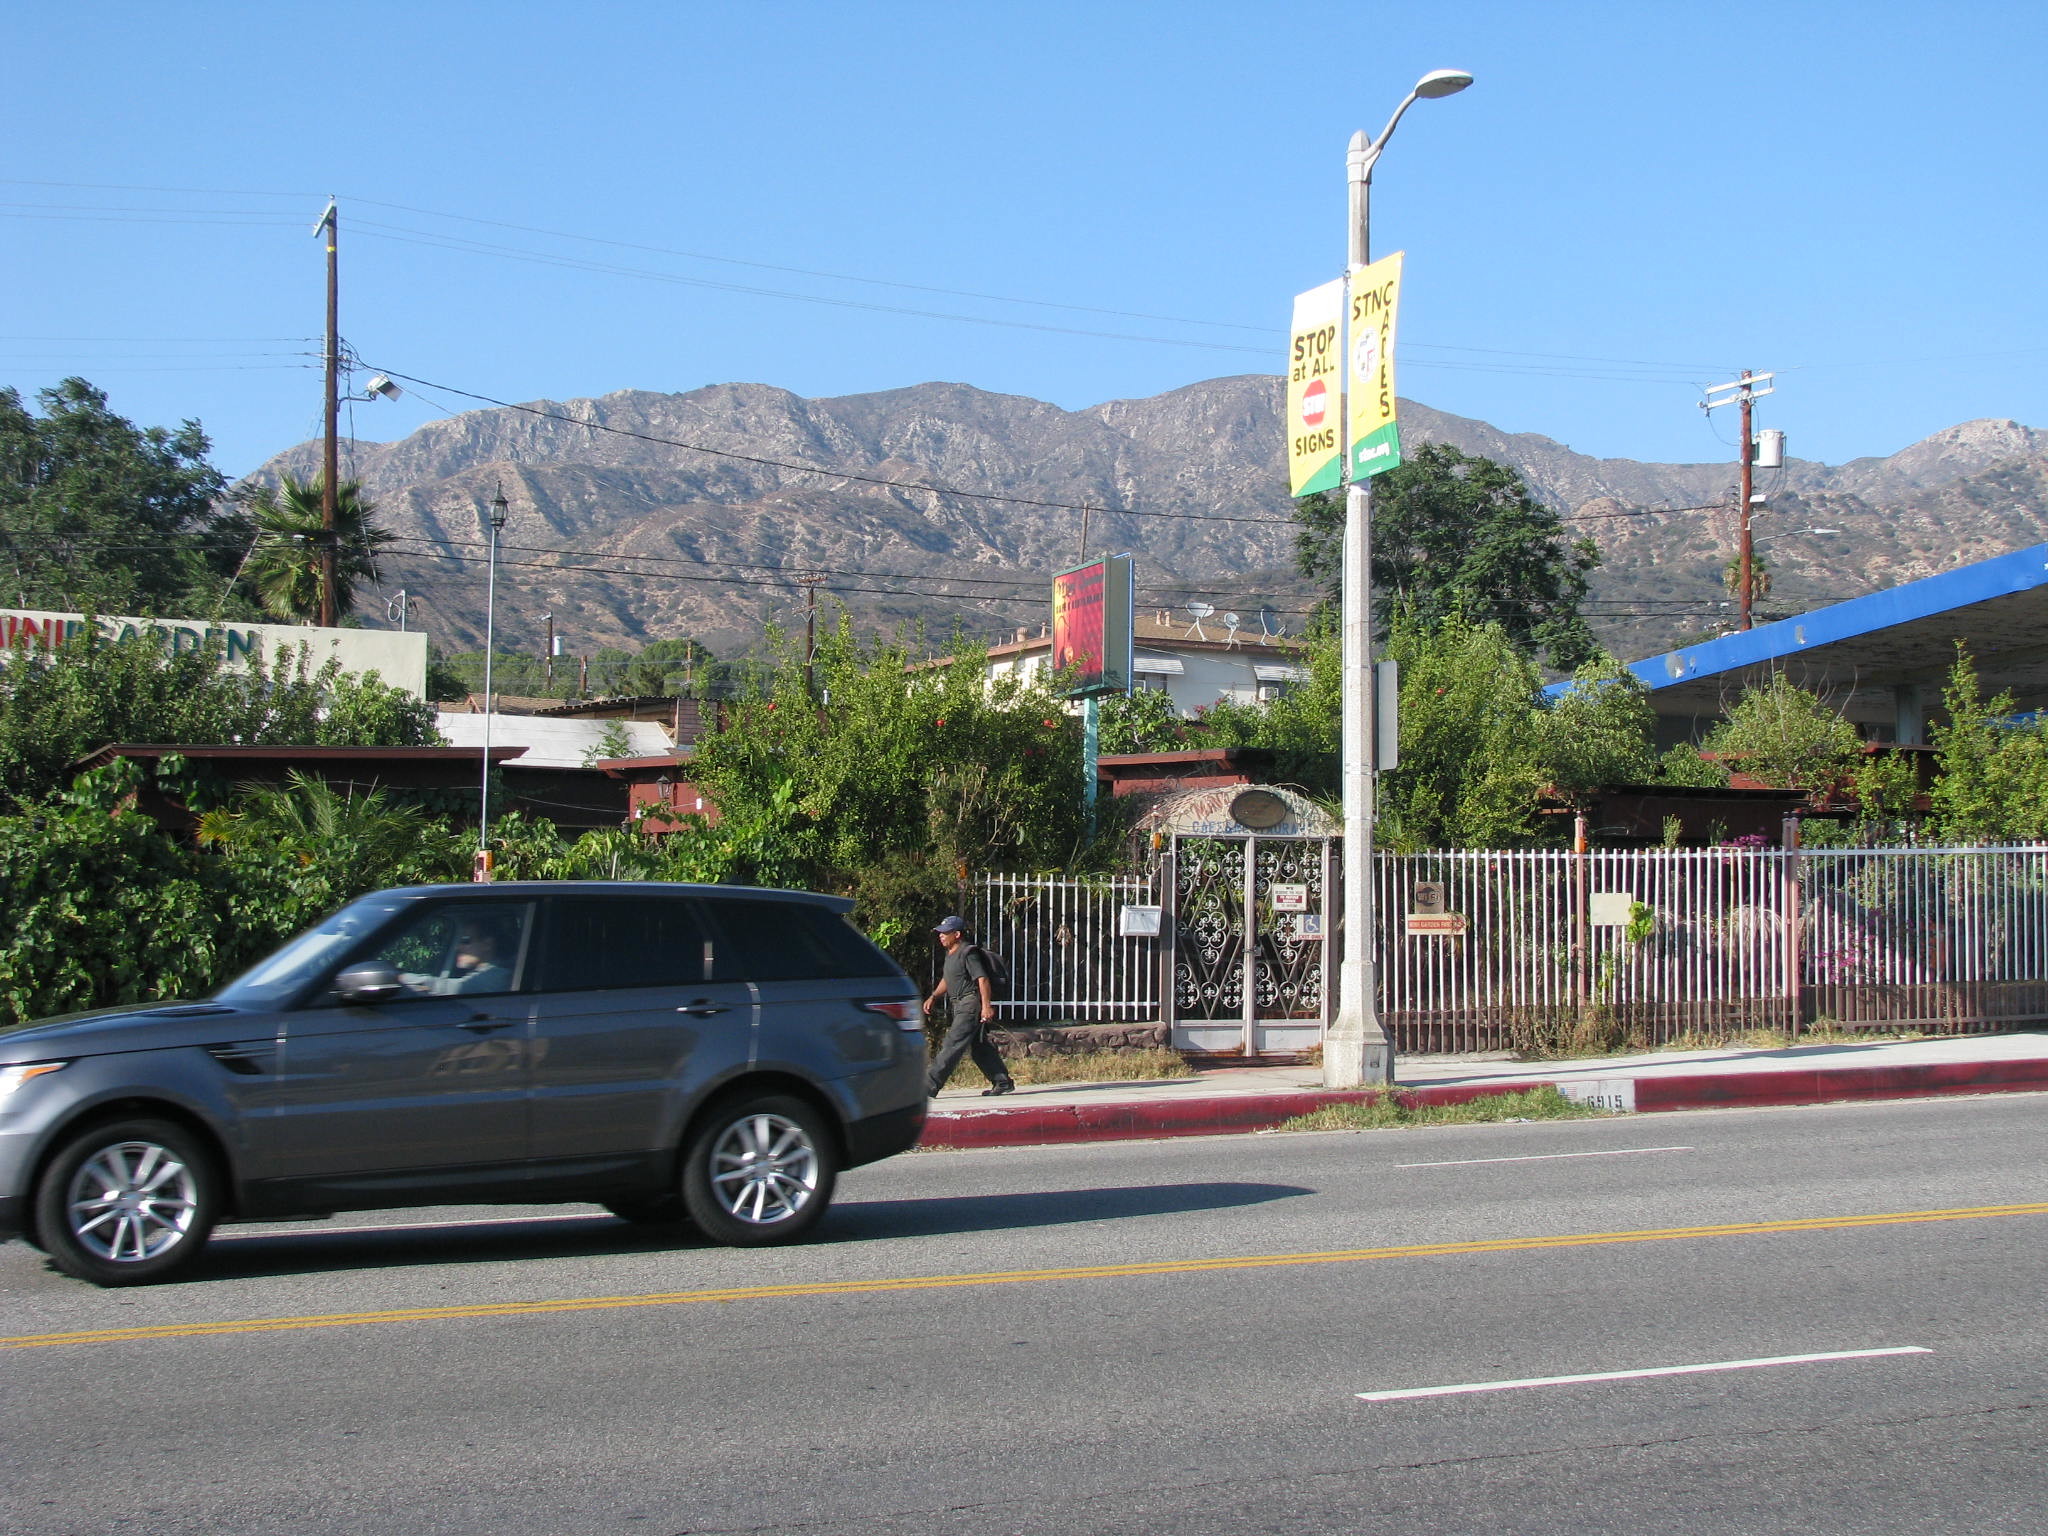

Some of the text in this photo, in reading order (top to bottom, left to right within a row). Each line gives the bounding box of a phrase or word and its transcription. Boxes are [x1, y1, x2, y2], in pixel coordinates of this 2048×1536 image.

[1353, 281, 1393, 321] STNC
[1294, 325, 1336, 362] STOP
[1293, 362, 1306, 382] at
[1296, 428, 1335, 457] SIGNS
